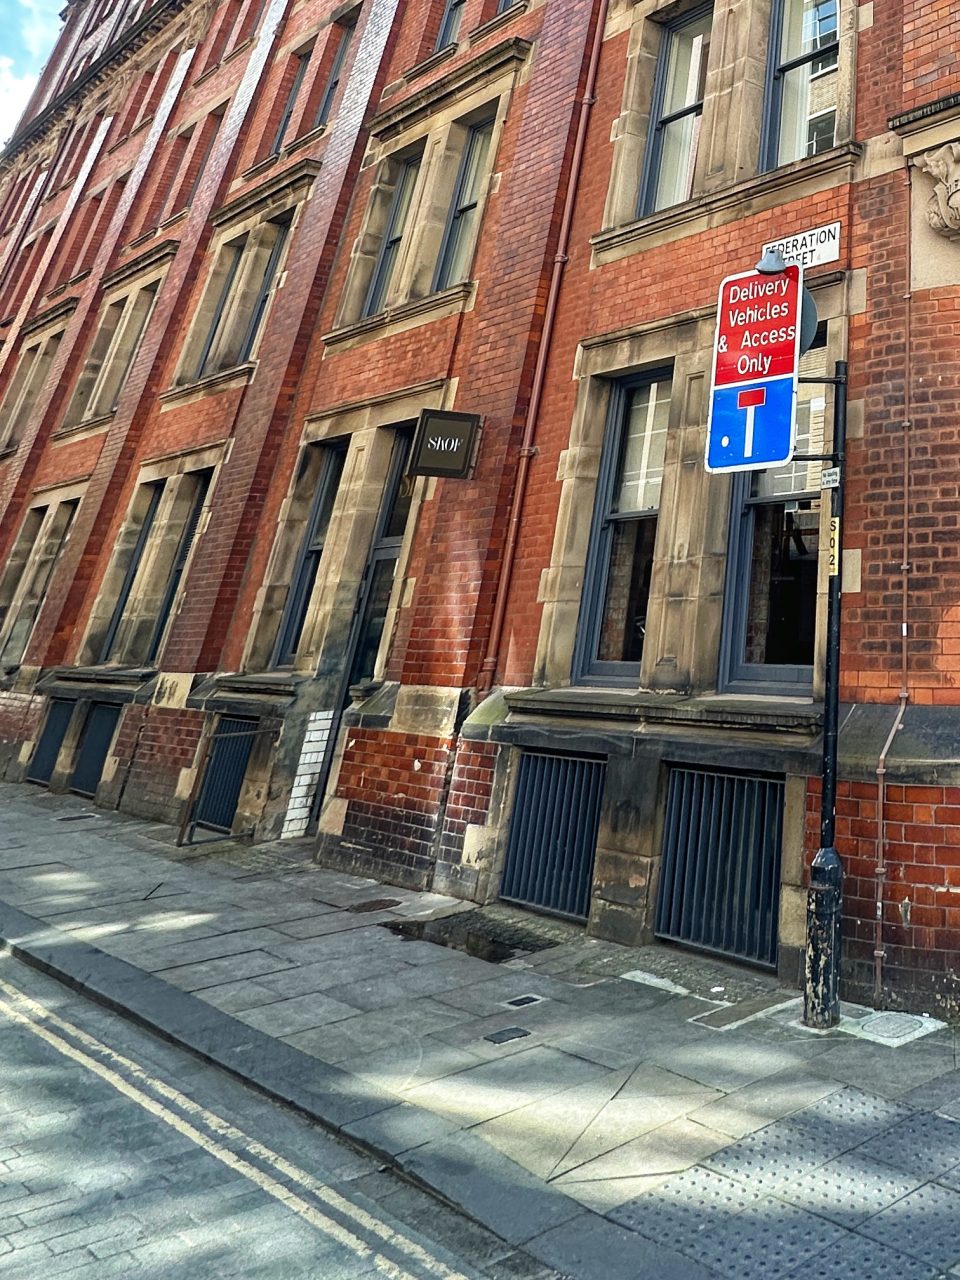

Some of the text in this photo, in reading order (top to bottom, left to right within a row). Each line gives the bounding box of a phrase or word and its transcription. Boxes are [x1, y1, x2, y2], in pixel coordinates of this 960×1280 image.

[766, 227, 836, 254] DERATION
[729, 278, 790, 304] Delivery
[729, 300, 789, 327] Vehicles
[717, 324, 796, 353] & Access
[737, 355, 772, 375] Only
